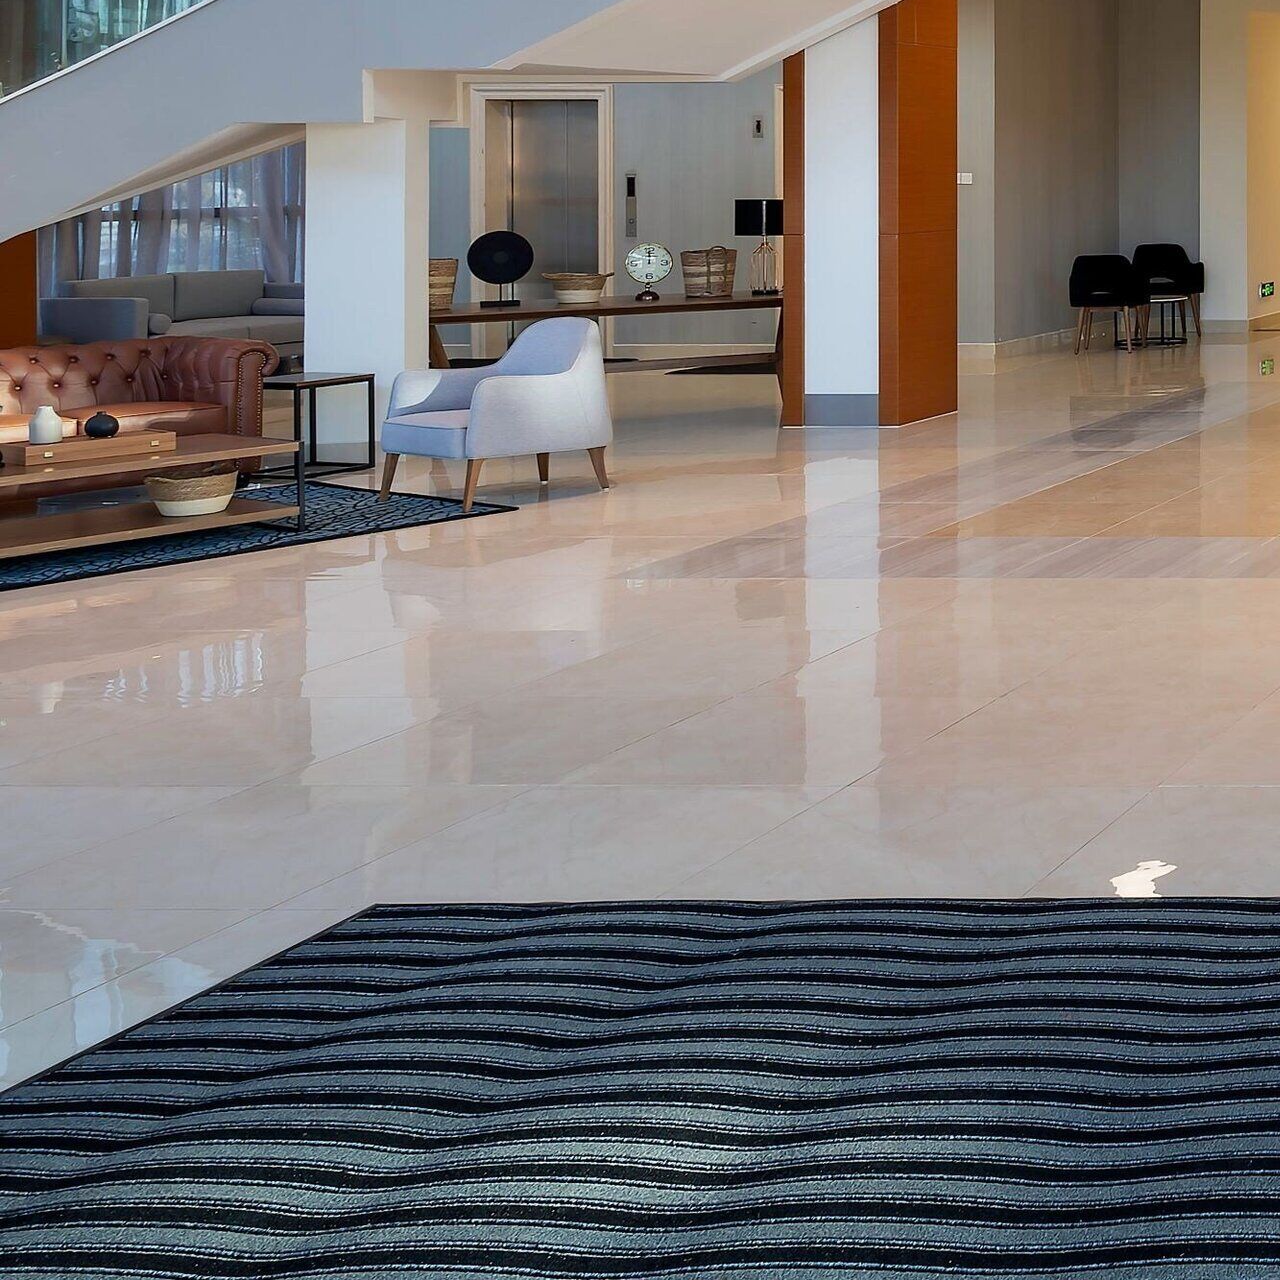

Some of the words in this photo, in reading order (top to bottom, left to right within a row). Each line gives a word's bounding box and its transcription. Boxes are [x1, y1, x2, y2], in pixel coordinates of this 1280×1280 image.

[644, 247, 655, 255] 12
[660, 259, 669, 267] 3
[645, 272, 654, 280] 6
